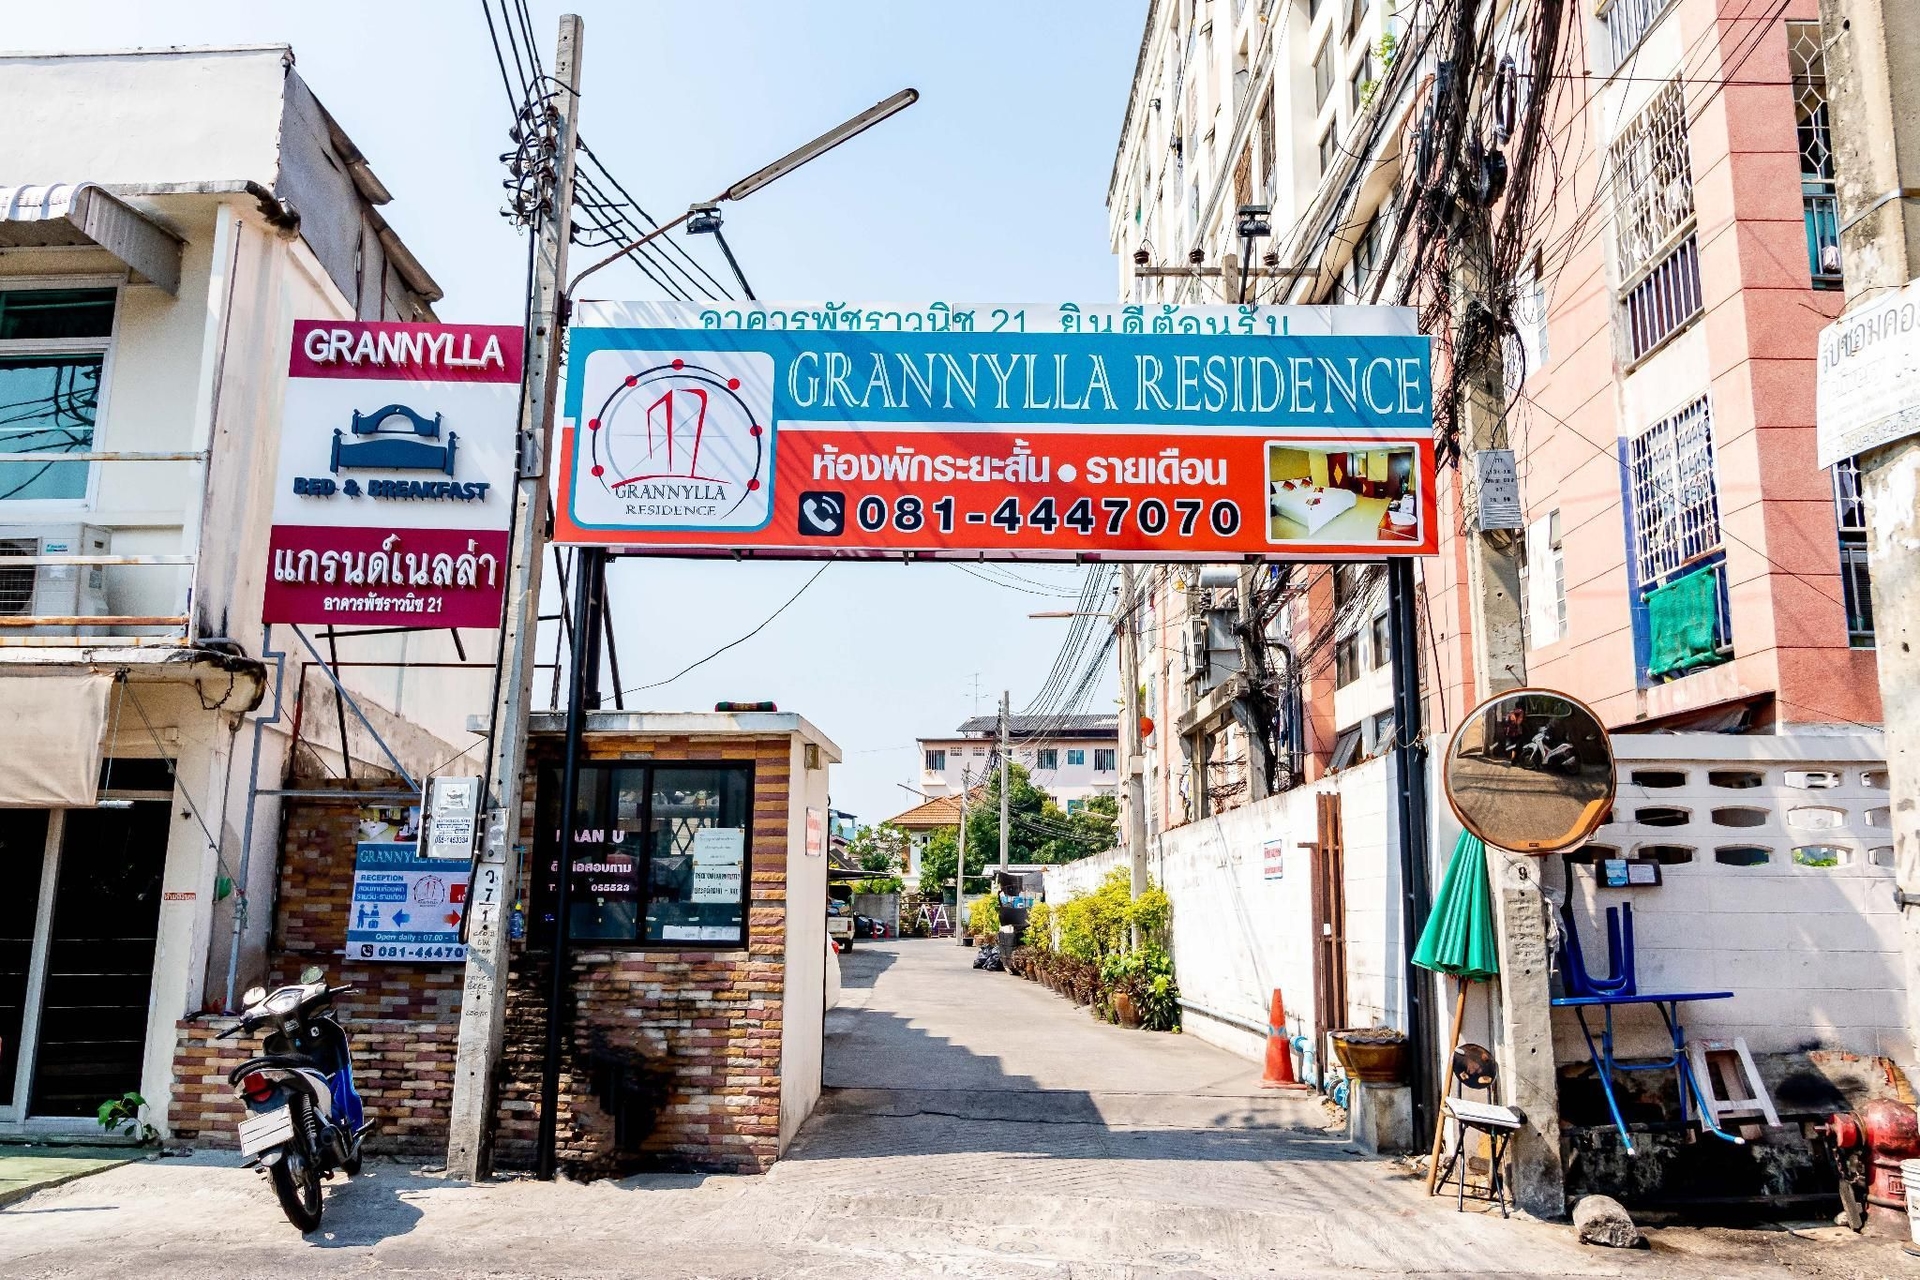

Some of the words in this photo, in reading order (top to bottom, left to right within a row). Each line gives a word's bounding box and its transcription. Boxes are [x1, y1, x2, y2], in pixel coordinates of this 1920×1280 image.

[990, 308, 1026, 332] 21
[304, 328, 504, 368] GRANNYLLA
[788, 350, 1119, 411] GRANNYLLA
[1134, 354, 1424, 415] RESIDENCE
[812, 438, 1050, 483] ห้องพักระยะสั้น
[1086, 447, 1228, 486] รายเดือน
[293, 476, 337, 497] BED
[343, 478, 361, 498] &
[367, 479, 490, 501] BREAKFAST
[615, 483, 727, 501] GRANNYLLA
[625, 504, 717, 516] RESIDENCE
[856, 494, 1241, 538] 081-4447070
[274, 533, 497, 587] แกรนด์เนลล่า
[427, 596, 442, 612] 21
[360, 874, 404, 882] RECEPTION
[1518, 866, 1528, 881] 9
[375, 933, 397, 942] Open
[399, 933, 415, 942] daily
[378, 946, 469, 958] 081-44470
